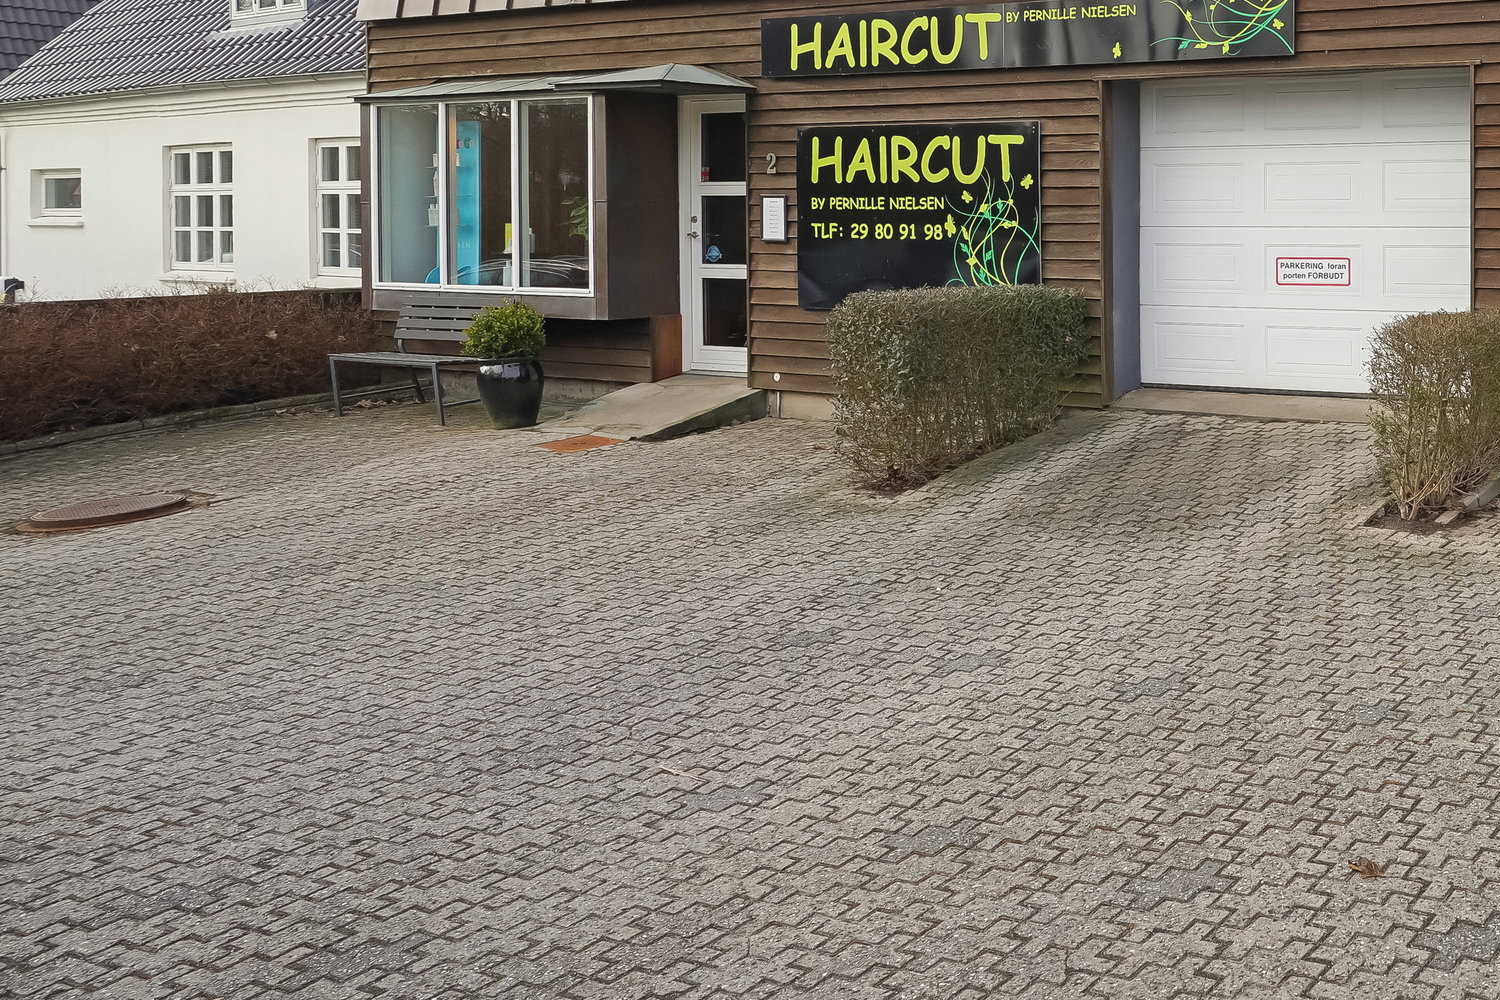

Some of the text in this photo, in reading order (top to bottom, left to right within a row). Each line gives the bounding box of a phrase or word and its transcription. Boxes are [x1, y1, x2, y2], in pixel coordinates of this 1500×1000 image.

[1006, 4, 1137, 23] BY PERNILLE NIELSEN
[791, 13, 1002, 71] HAIRCUT
[766, 153, 777, 174] 2
[811, 134, 1025, 184] HAIRCUT
[811, 197, 945, 210] BY PERNILLE NIELSEN
[811, 222, 943, 240] TLF: 29 80 91 98
